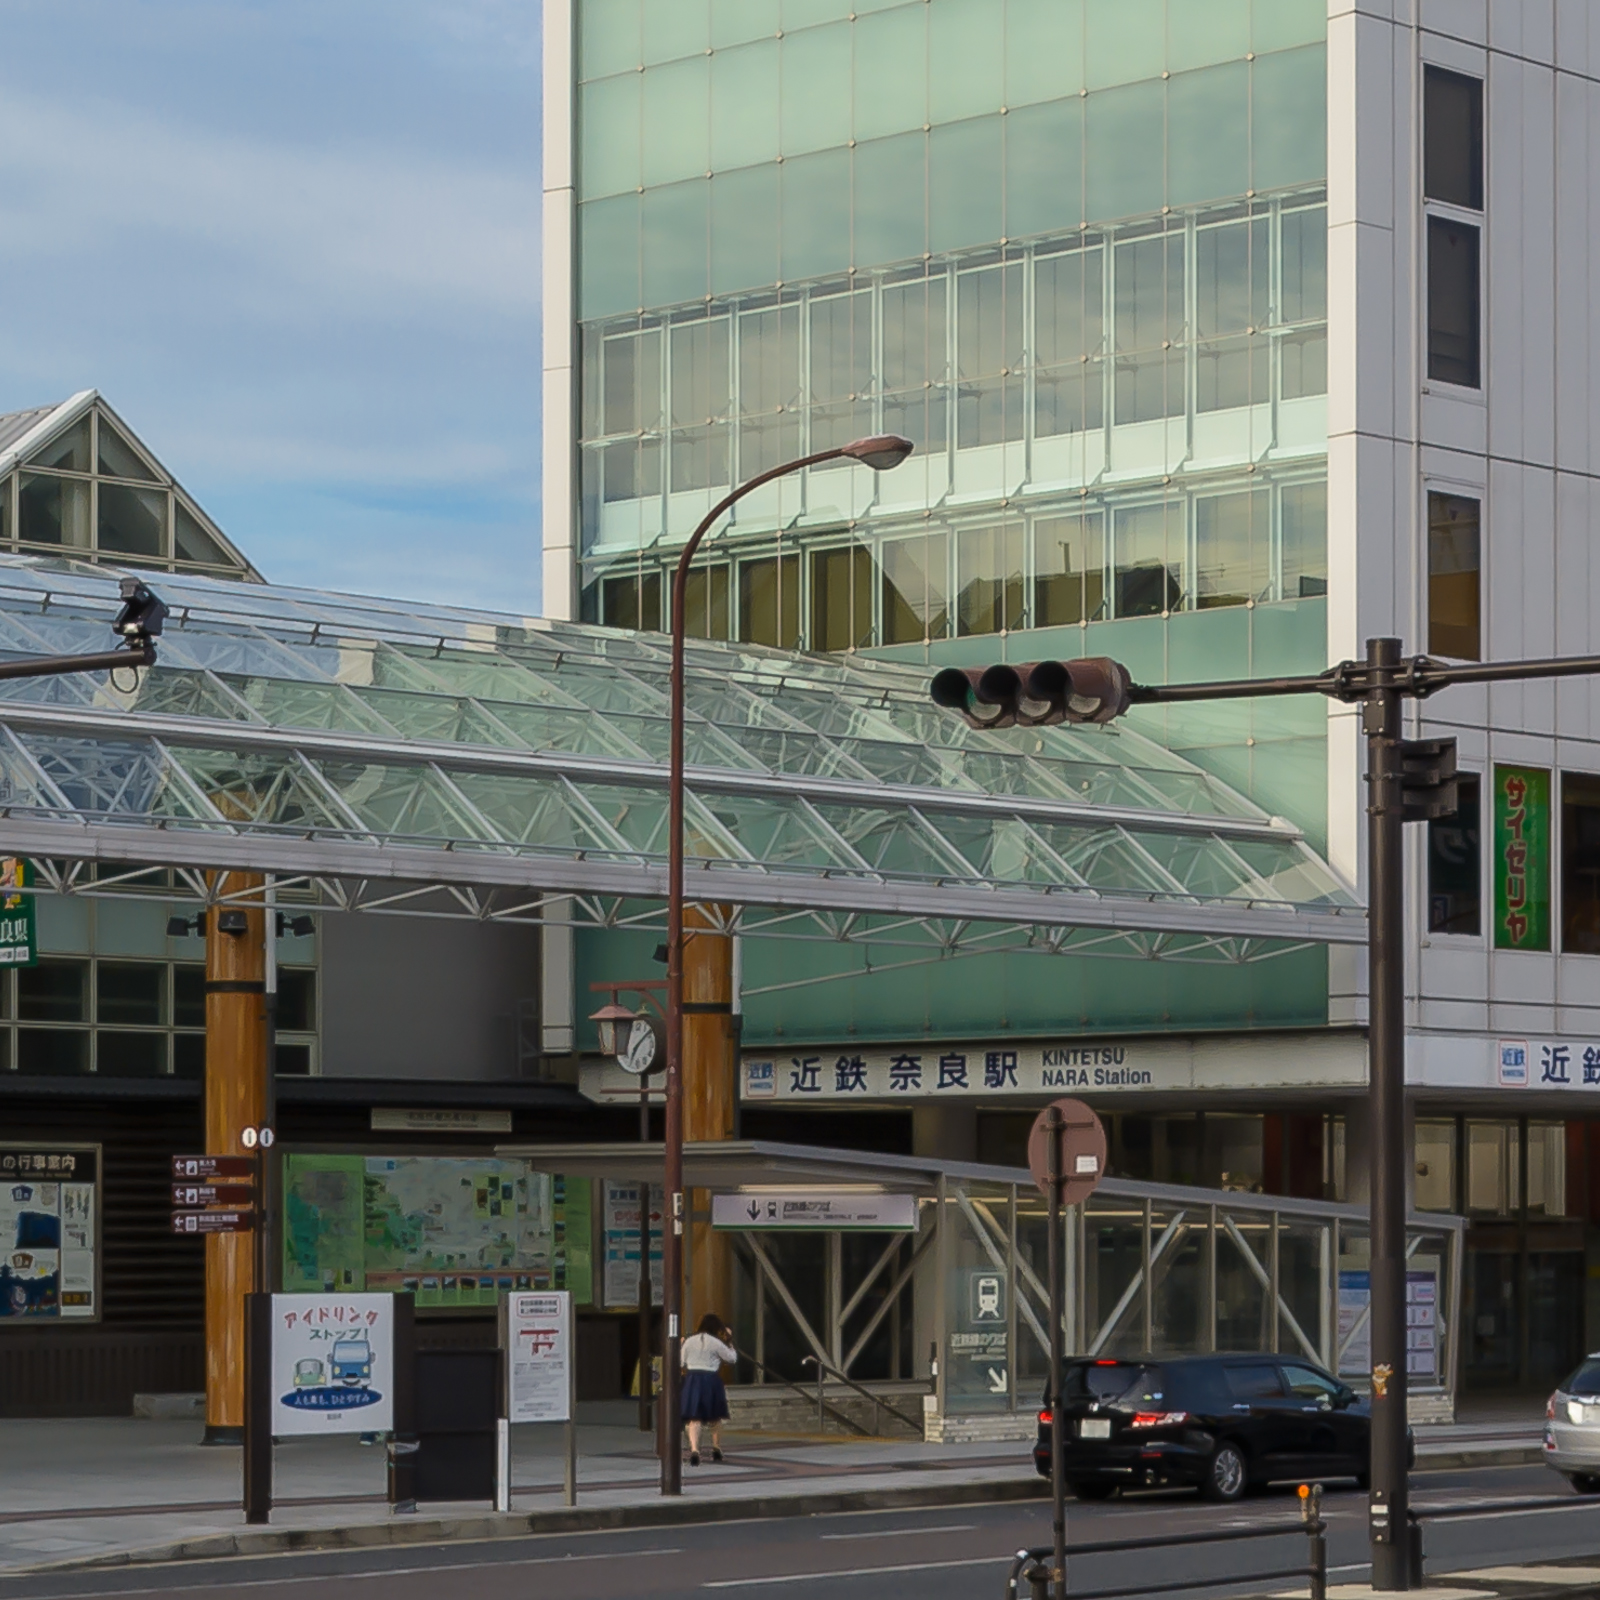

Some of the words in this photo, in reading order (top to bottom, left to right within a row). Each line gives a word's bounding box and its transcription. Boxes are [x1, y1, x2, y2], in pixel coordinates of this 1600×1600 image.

[1505, 776, 1527, 943] サイゼリヤ
[789, 1050, 1019, 1094] 近鉄奈良駅
[1041, 1046, 1126, 1068] KINTETSU
[1041, 1067, 1089, 1088] NARA
[1093, 1066, 1152, 1087] Station
